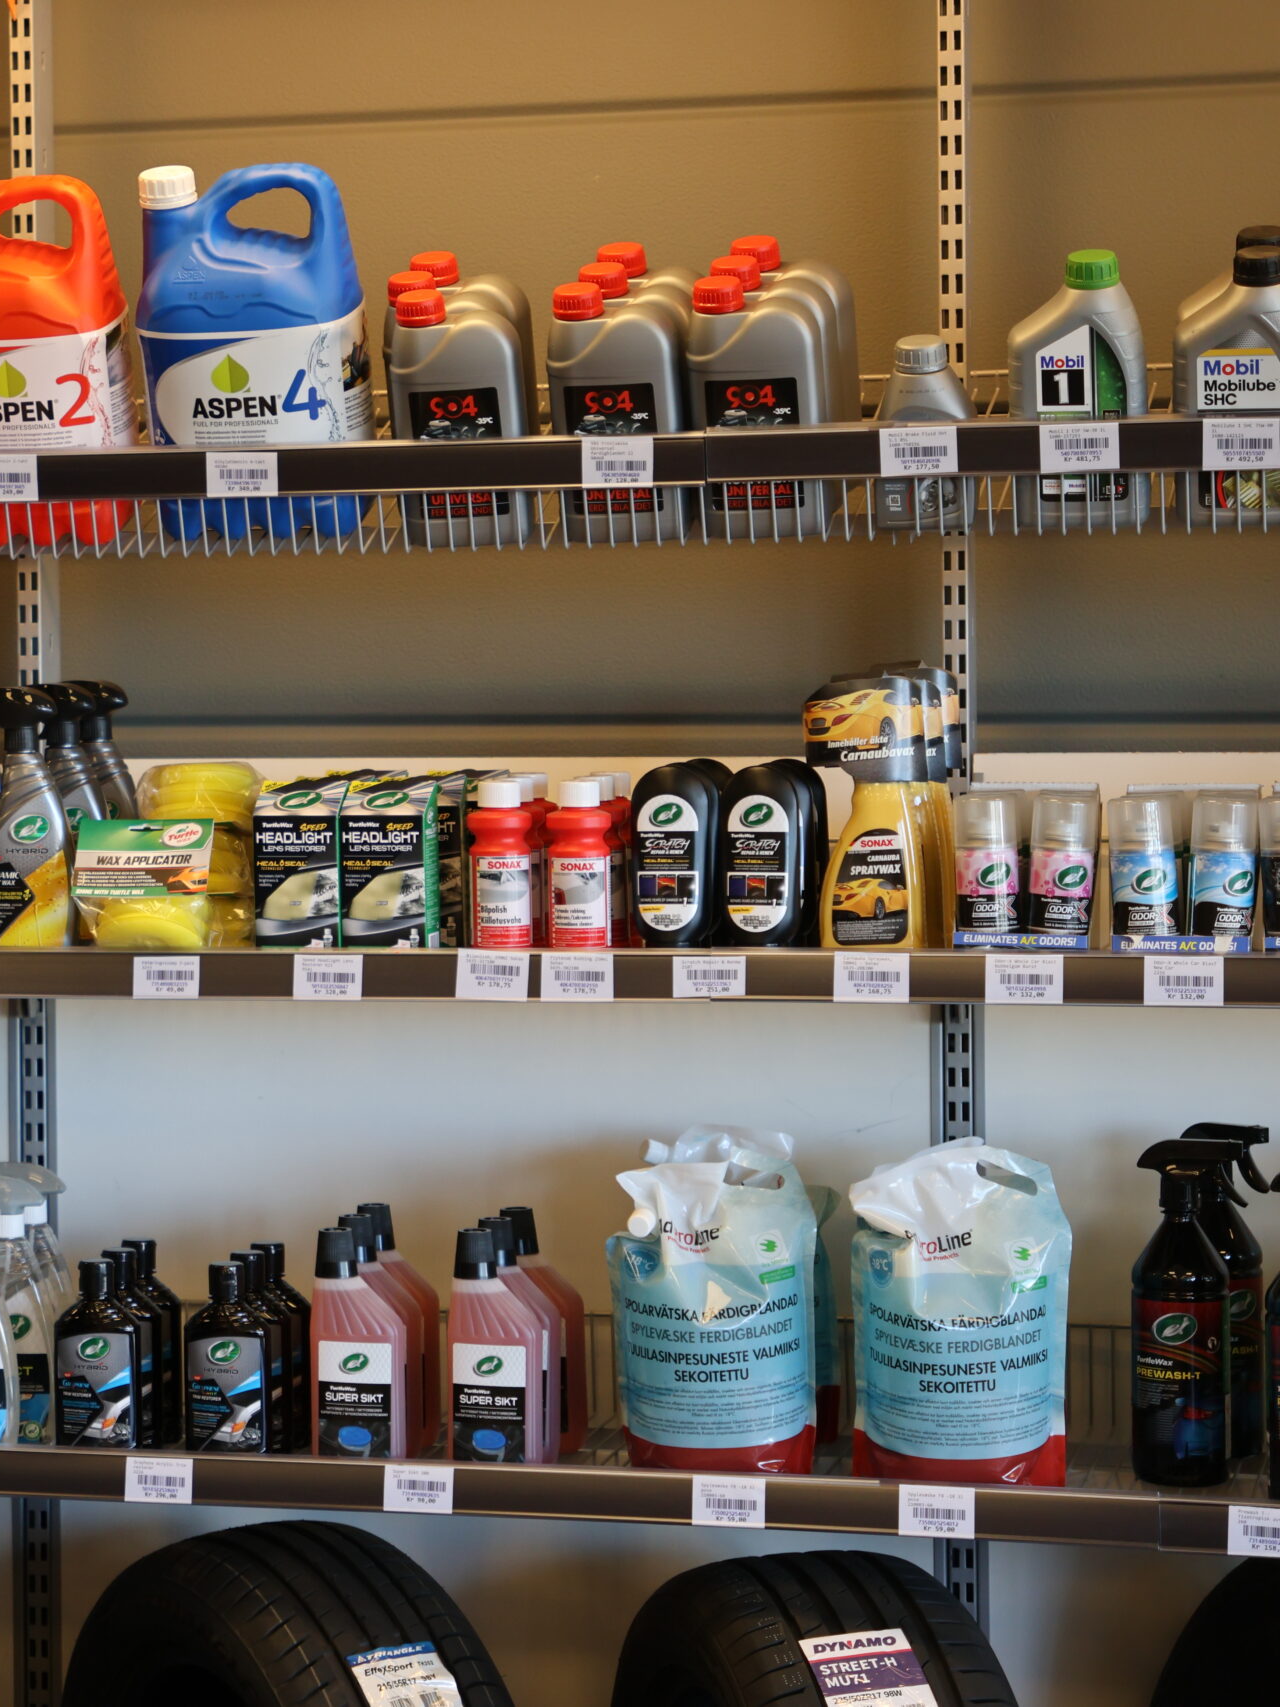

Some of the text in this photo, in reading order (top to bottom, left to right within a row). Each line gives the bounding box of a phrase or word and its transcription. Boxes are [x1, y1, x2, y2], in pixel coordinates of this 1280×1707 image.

[1040, 355, 1084, 369] Mobil
[1203, 359, 1260, 376] Mobil
[1053, 372, 1070, 405] 1
[1203, 379, 1276, 392] Mobilube
[55, 373, 96, 427] 2
[192, 395, 278, 419] ASPEN
[282, 369, 326, 421] 4
[1203, 393, 1237, 406] SHC
[2, 423, 56, 431] PROFESSIONALS
[224, 419, 279, 427] PROFESSIONALS
[827, 735, 889, 749] Innehåller äkta
[840, 746, 915, 762] Carnaubavax
[299, 822, 327, 831] SPEED
[385, 822, 413, 830] SPEED
[255, 831, 333, 844] HEADLIGHT
[341, 830, 419, 844] HEADLIGHT
[860, 838, 894, 848] SONAX
[5, 847, 49, 855] HYBRID
[349, 844, 412, 852] LENS RESTORER
[640, 838, 691, 853] SCRATCH
[731, 839, 781, 854] SCRATCH
[96, 854, 193, 865] WAX APPLICATOR
[867, 853, 900, 862] CARNAUBA
[487, 861, 522, 870] SONAX
[560, 863, 595, 871] SONAX
[850, 864, 901, 875] SPRAYWAX
[480, 905, 508, 915] Bilpolish
[1048, 899, 1090, 922] ODOR-X
[963, 934, 1077, 947] ELIMINATES A/C ODORS!
[1120, 940, 1237, 951] ELIMINATES A/C ODS!
[624, 1296, 699, 1322] SPOLARVÄTSKA
[869, 1302, 947, 1332] SPOLARVÄTSKA
[631, 1318, 793, 1344] SPYLEVÆSKE FERDIGBLANDET
[874, 1328, 1042, 1354] SPYLEVÆSKE FERDIGBLANDET
[627, 1337, 801, 1367] TUULILASINPESUNESTE VALMIIKSI
[869, 1347, 1048, 1376] TUULILASINPESUNESTE VALMIIKSI
[1136, 1356, 1174, 1367] TurtleWax
[674, 1367, 749, 1383] SEKOITETTU
[1136, 1367, 1201, 1380] PREWASH-T
[919, 1380, 996, 1394] SEKOITETTU
[325, 1392, 384, 1404] SUPER SIKT
[459, 1395, 518, 1406] SUPER SIKT
[813, 1636, 897, 1654] DYNAMO
[365, 1645, 424, 1661] TRIANGLE
[820, 1657, 898, 1676] STREET-H
[824, 1674, 871, 1689] MU71
